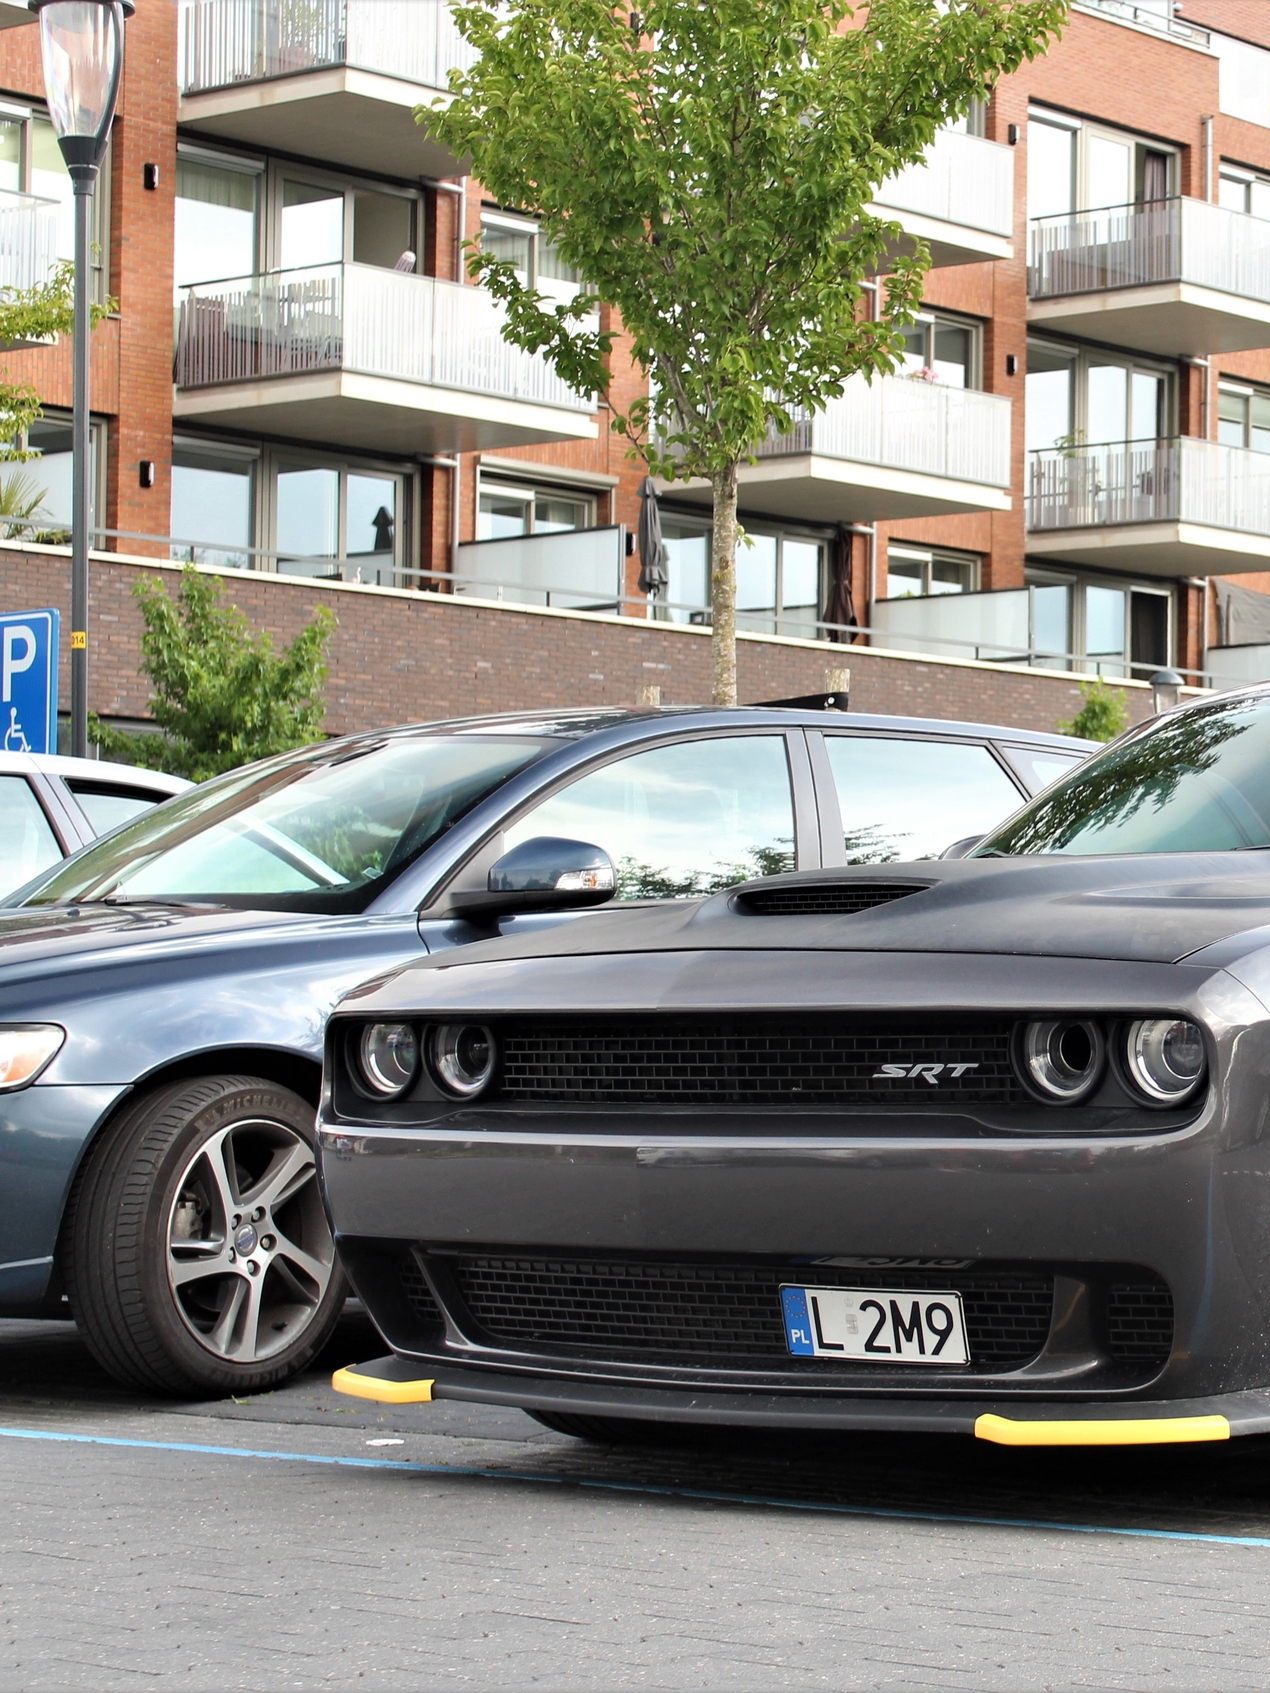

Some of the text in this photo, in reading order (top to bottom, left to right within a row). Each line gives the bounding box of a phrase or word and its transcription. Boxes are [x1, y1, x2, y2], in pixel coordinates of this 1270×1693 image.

[3, 625, 37, 702] P
[872, 1063, 979, 1084] SRT
[791, 1329, 810, 1345] PL
[811, 1296, 954, 1355] L 2M9
